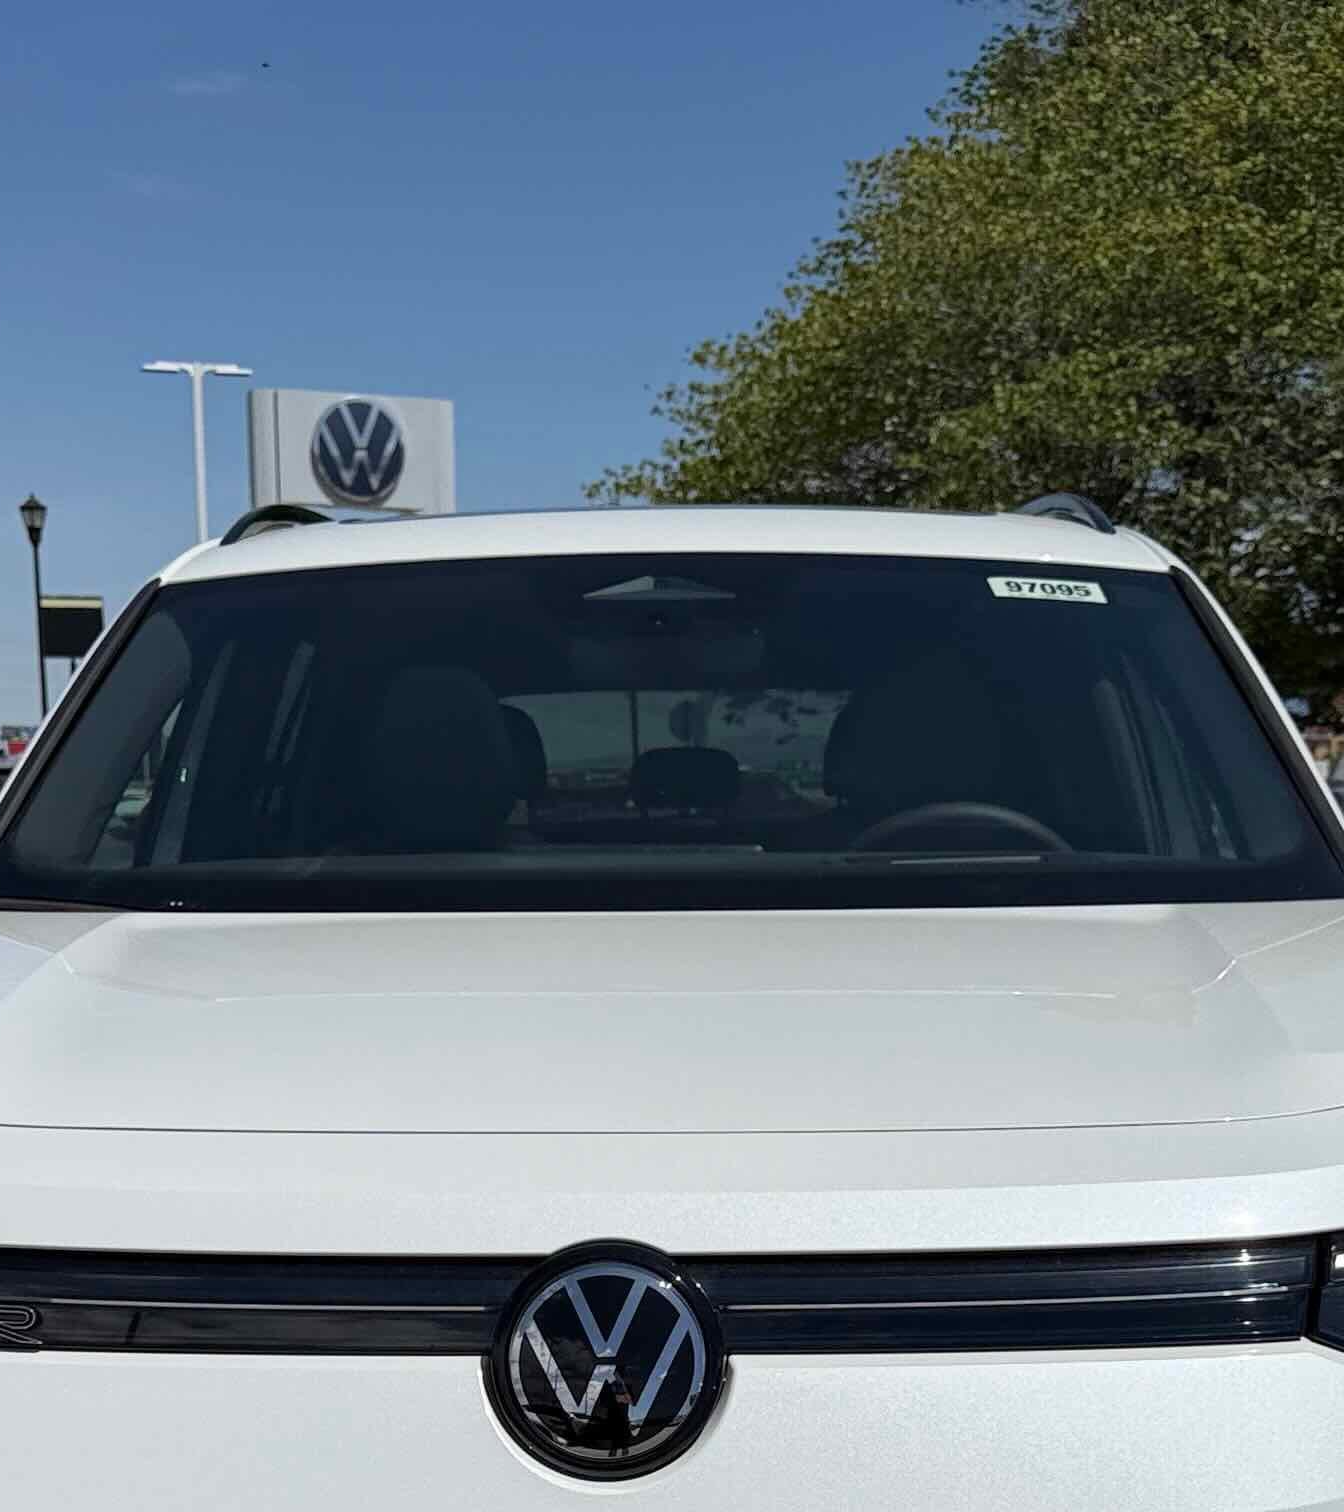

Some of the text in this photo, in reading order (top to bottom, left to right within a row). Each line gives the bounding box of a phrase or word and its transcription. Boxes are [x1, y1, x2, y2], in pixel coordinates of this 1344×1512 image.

[317, 400, 401, 494] VW
[1004, 580, 1092, 597] 97095
[517, 1267, 699, 1443] VW
